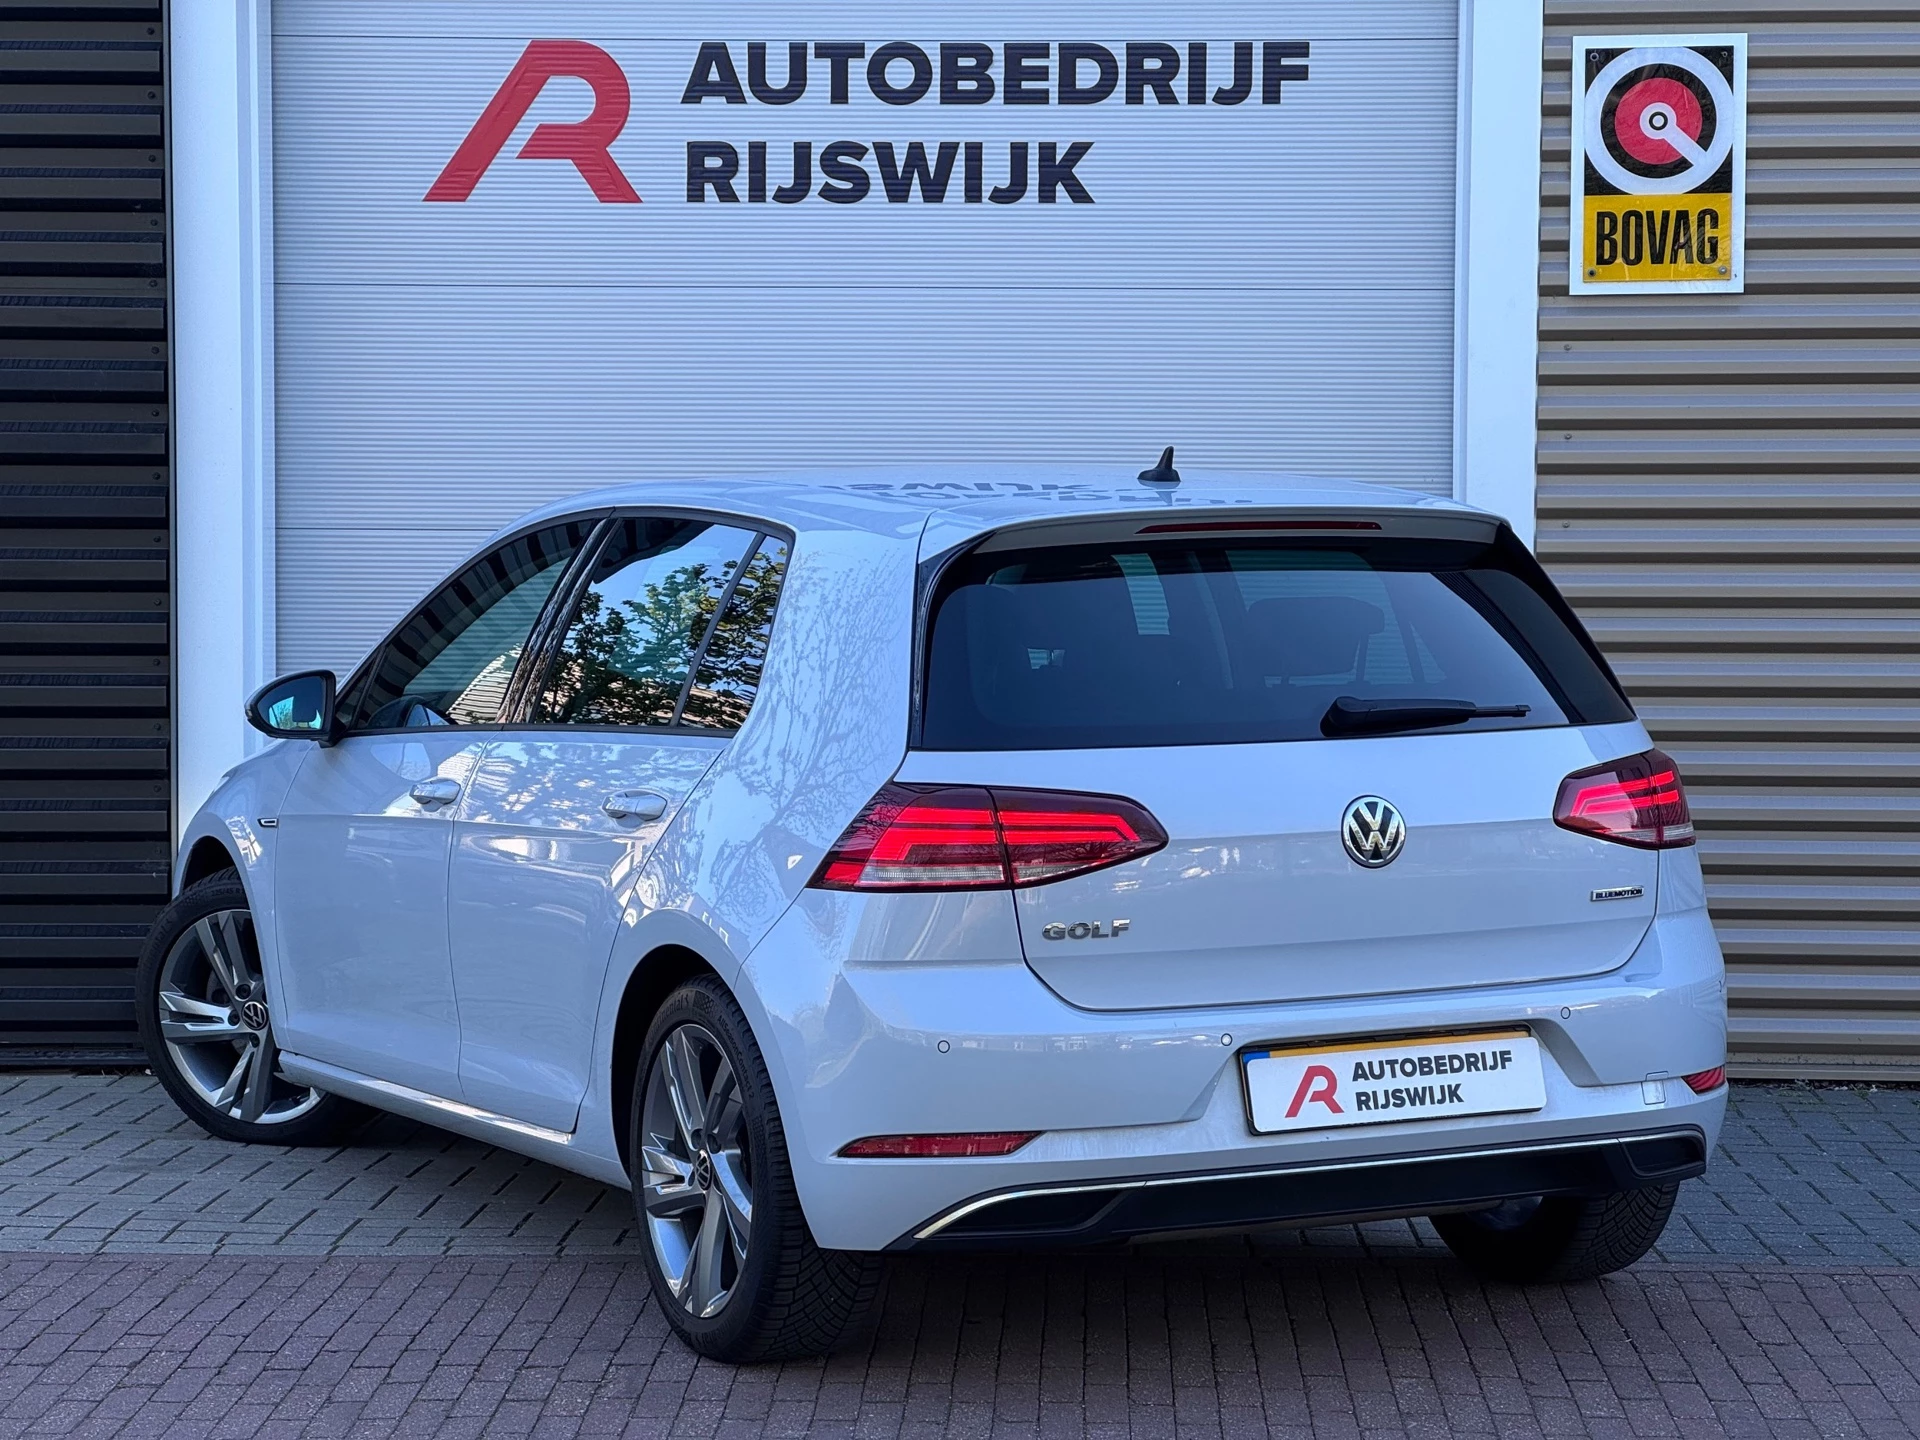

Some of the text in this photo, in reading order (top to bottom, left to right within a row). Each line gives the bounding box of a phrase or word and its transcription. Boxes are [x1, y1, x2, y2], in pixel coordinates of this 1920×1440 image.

[680, 41, 1311, 106] AUTOBEDRIJF
[686, 140, 1096, 205] RIJSWIJK
[1595, 208, 1720, 267] BOVAG
[1595, 888, 1643, 899] BLUEMOTION
[1041, 918, 1132, 942] GOLF
[1352, 1050, 1513, 1082] AUTOBEDRIJF
[1355, 1083, 1465, 1112] RIJSWIJK
